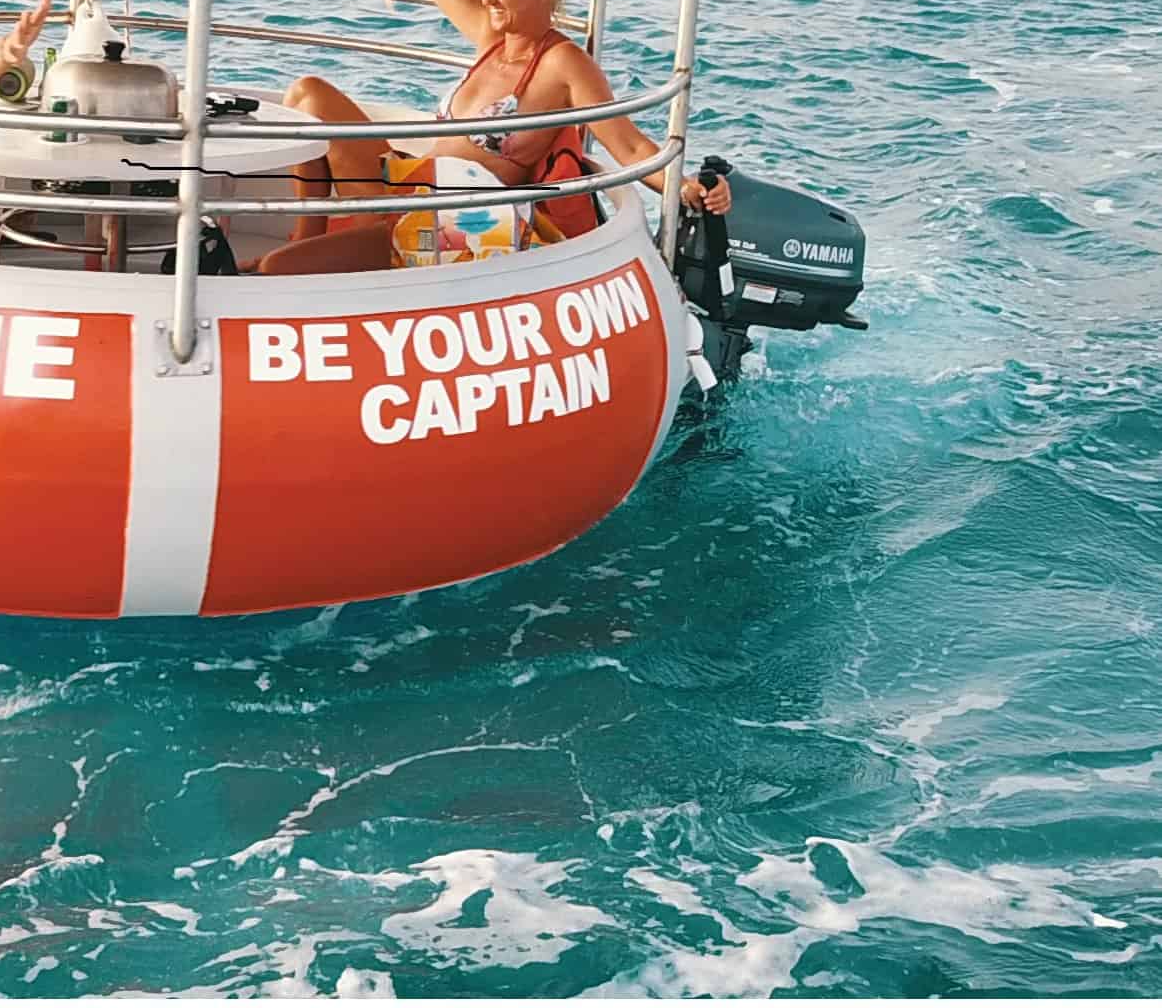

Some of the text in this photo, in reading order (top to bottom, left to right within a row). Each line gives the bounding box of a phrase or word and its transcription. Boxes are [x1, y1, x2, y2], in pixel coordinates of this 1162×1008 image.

[801, 242, 854, 264] YAMAHA
[248, 271, 650, 382] BE YOUR OWN
[360, 348, 611, 445] CAPTAIN
